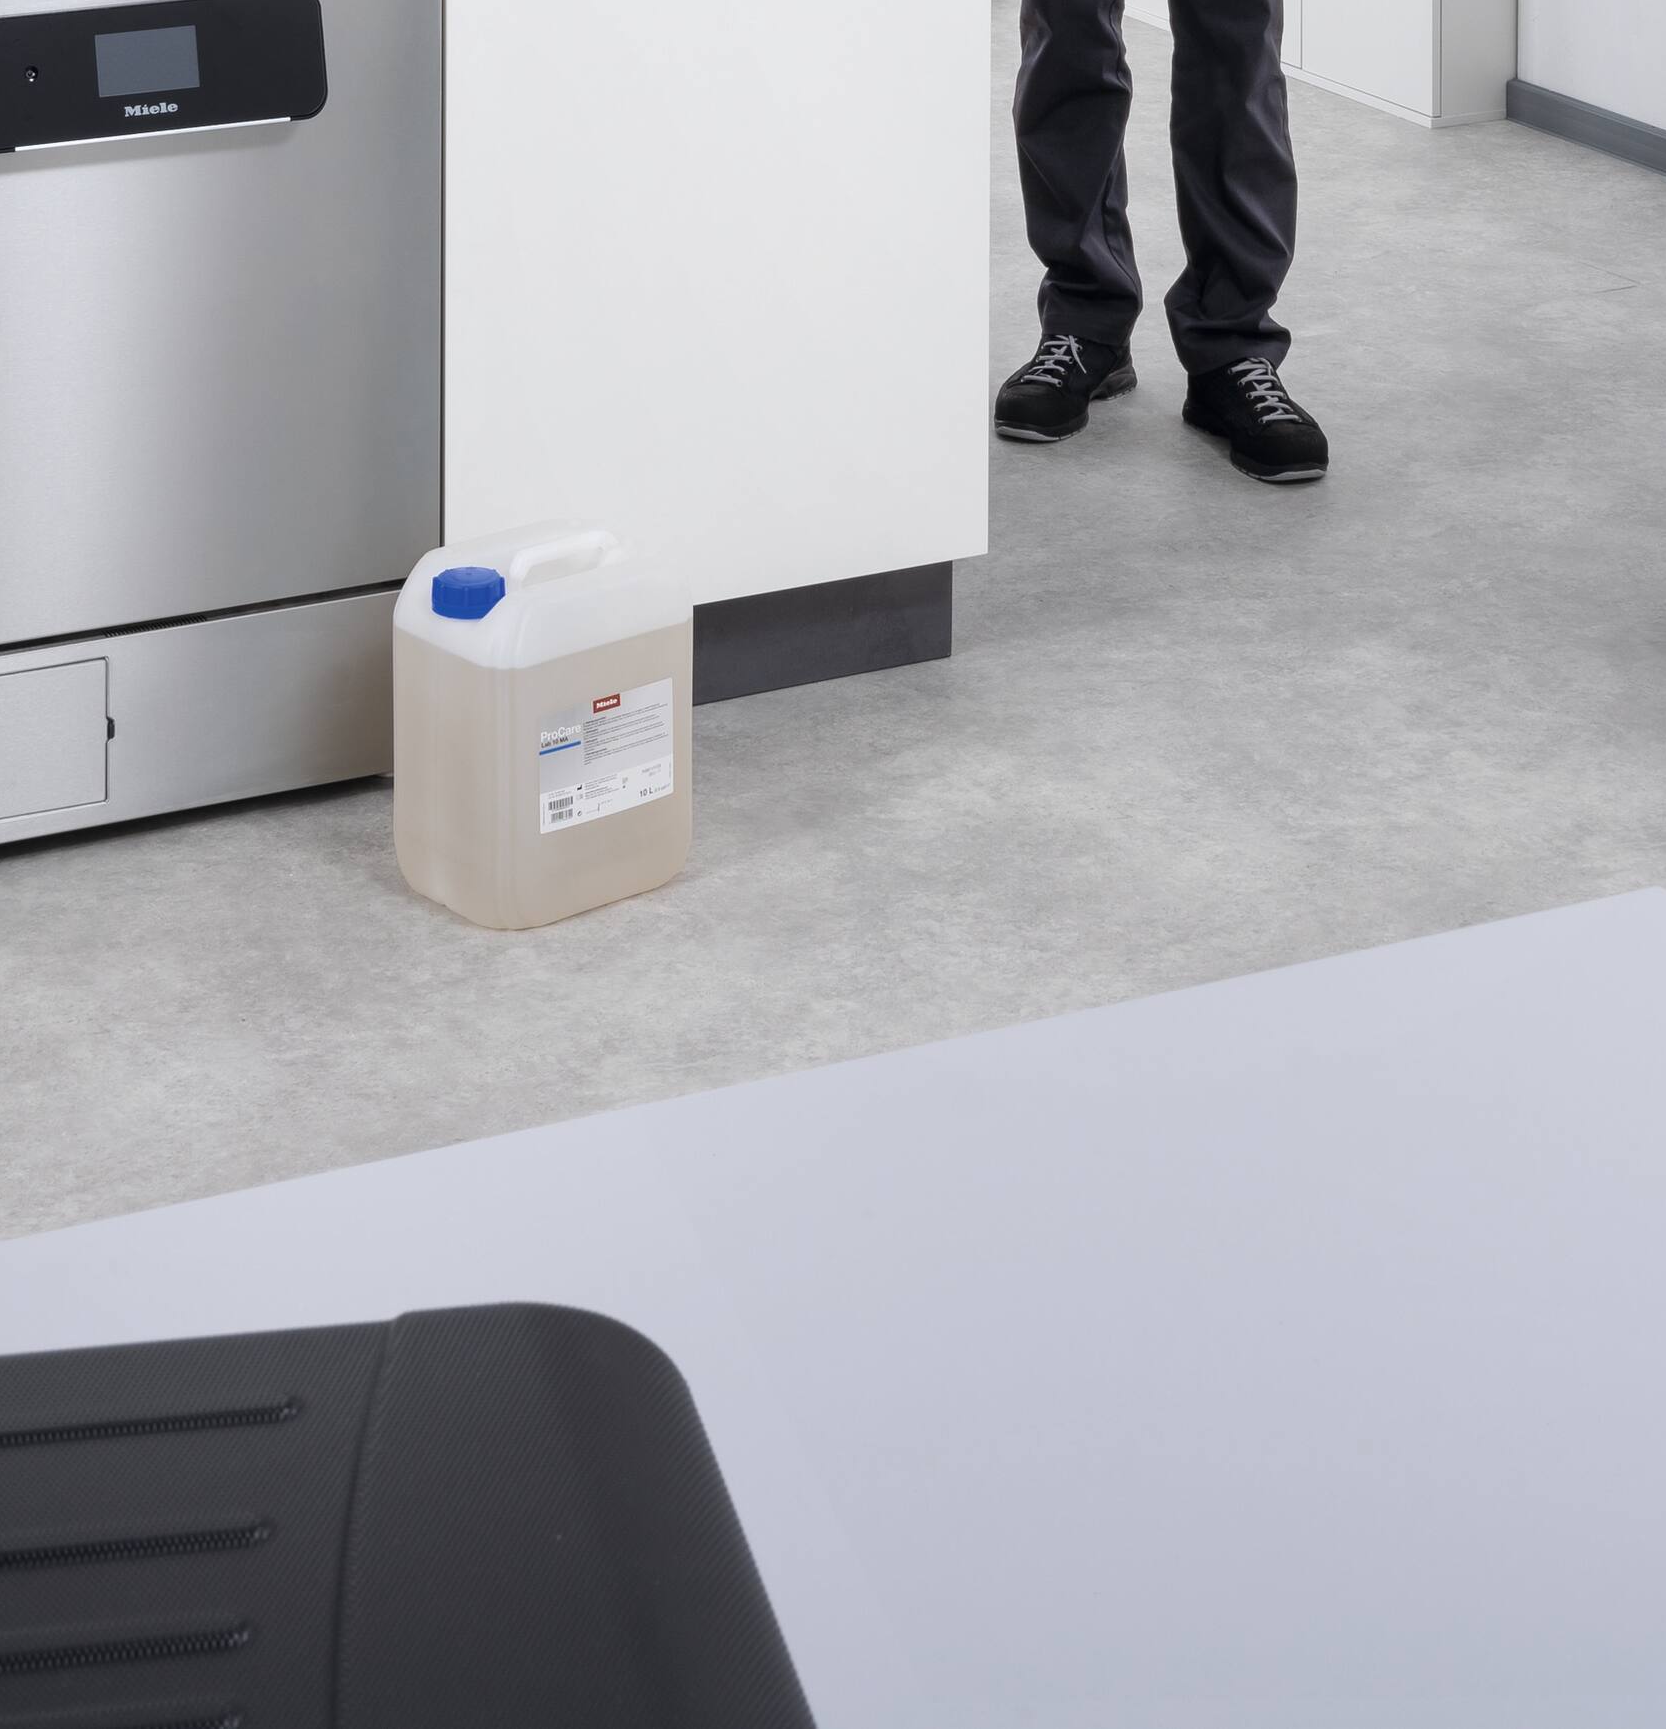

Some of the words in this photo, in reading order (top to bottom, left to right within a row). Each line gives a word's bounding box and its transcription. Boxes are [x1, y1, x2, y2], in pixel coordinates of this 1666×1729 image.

[124, 102, 179, 118] Miele
[596, 697, 618, 709] Miele
[540, 724, 582, 744] ProCare
[639, 788, 648, 798] 10
